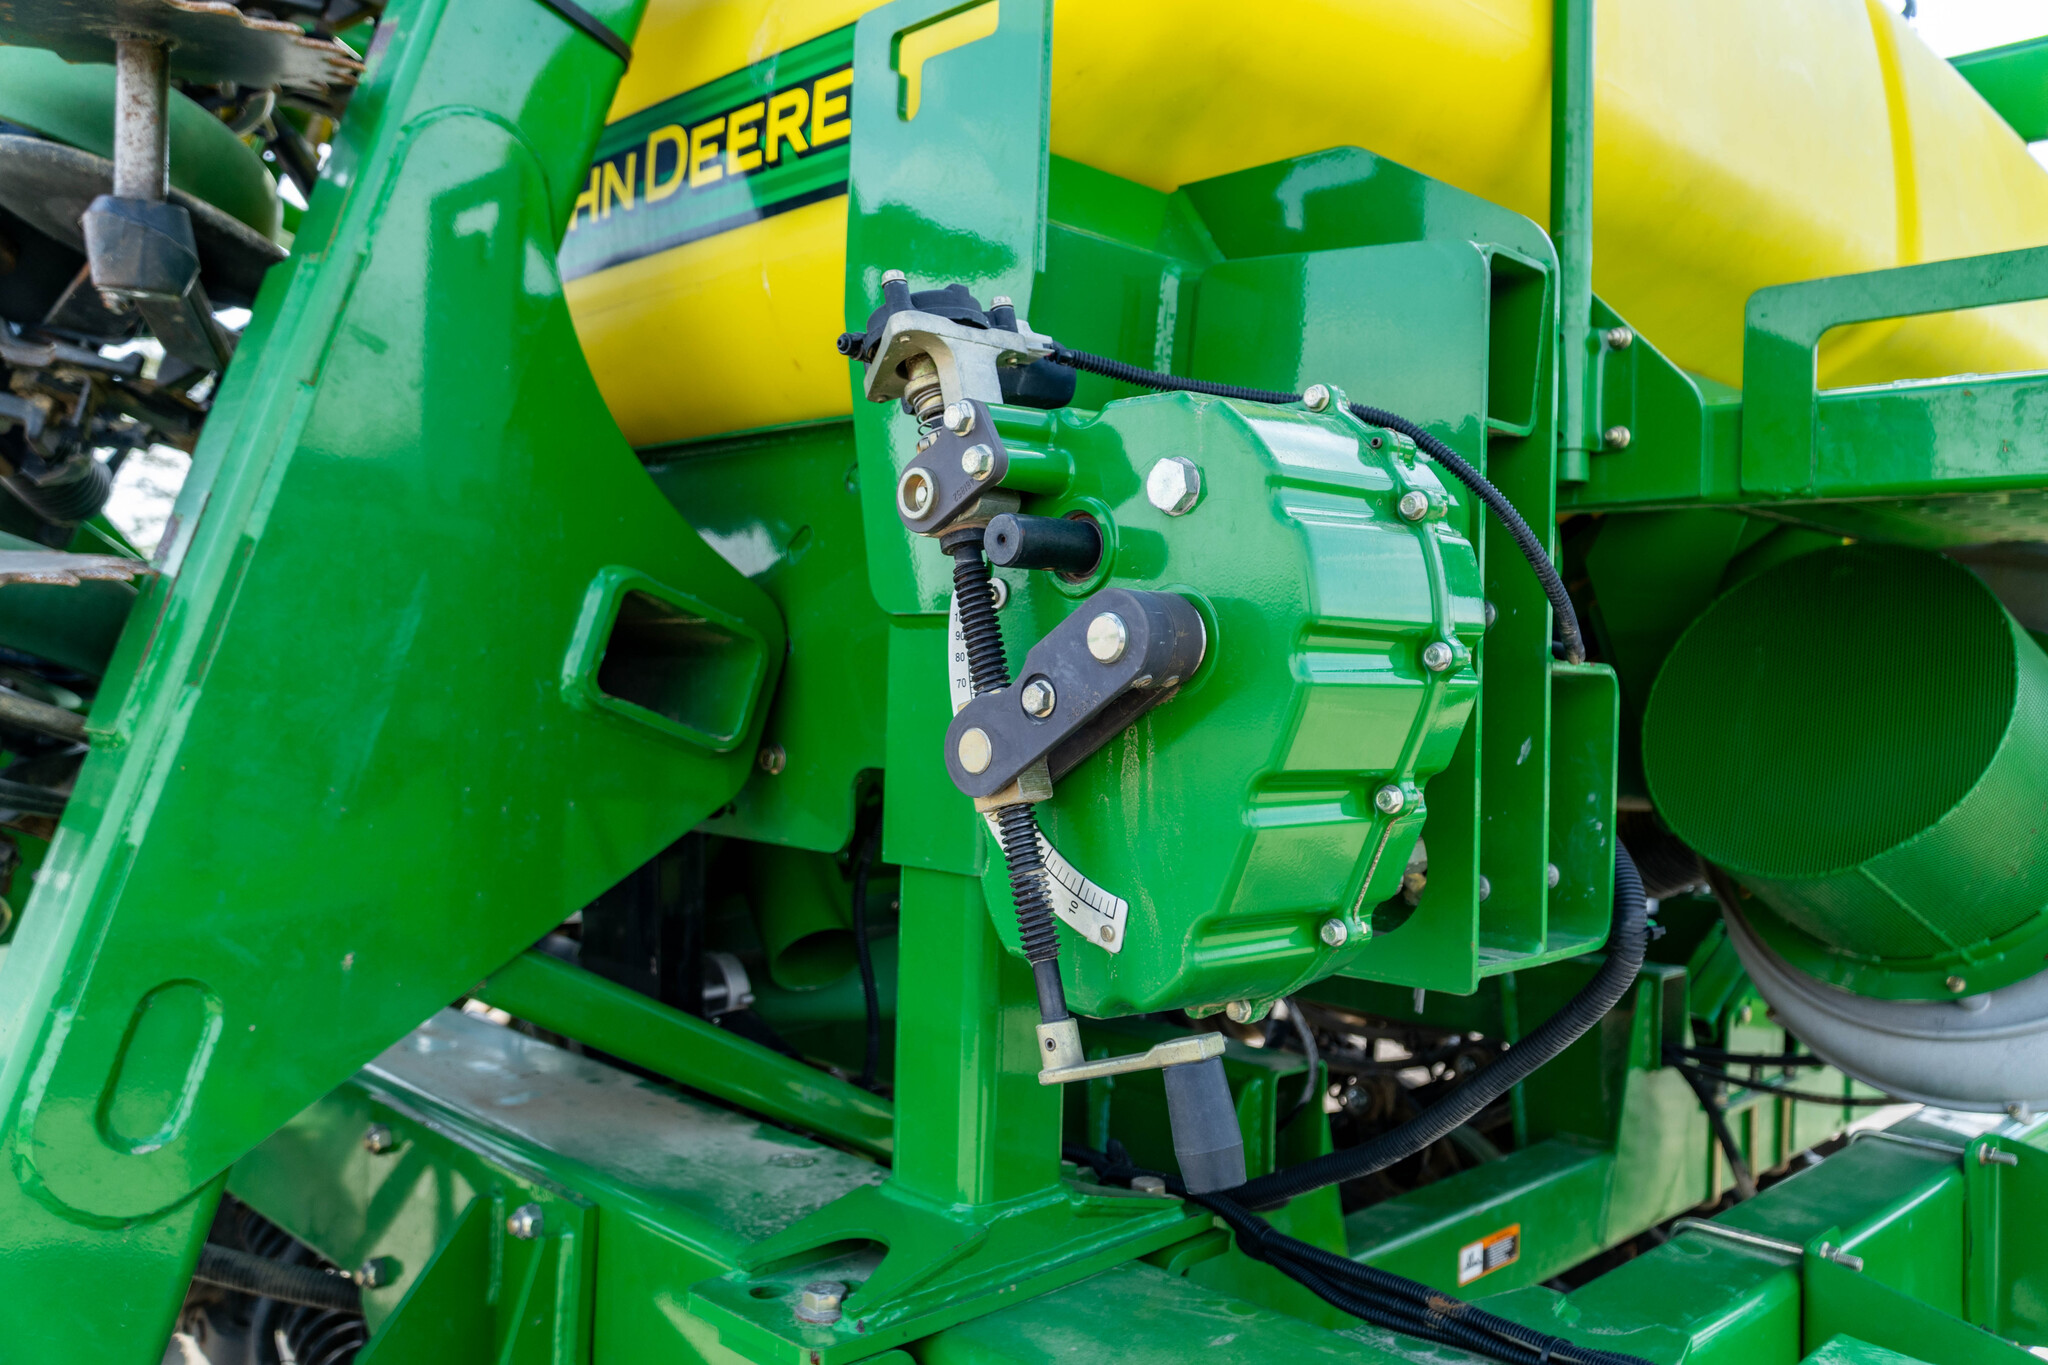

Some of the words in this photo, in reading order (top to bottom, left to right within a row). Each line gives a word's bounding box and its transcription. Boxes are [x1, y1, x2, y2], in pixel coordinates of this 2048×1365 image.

[568, 152, 637, 232] HN
[645, 67, 854, 204] DEERE
[955, 651, 965, 662] 80
[956, 677, 966, 688] 70
[1069, 900, 1078, 914] 10
